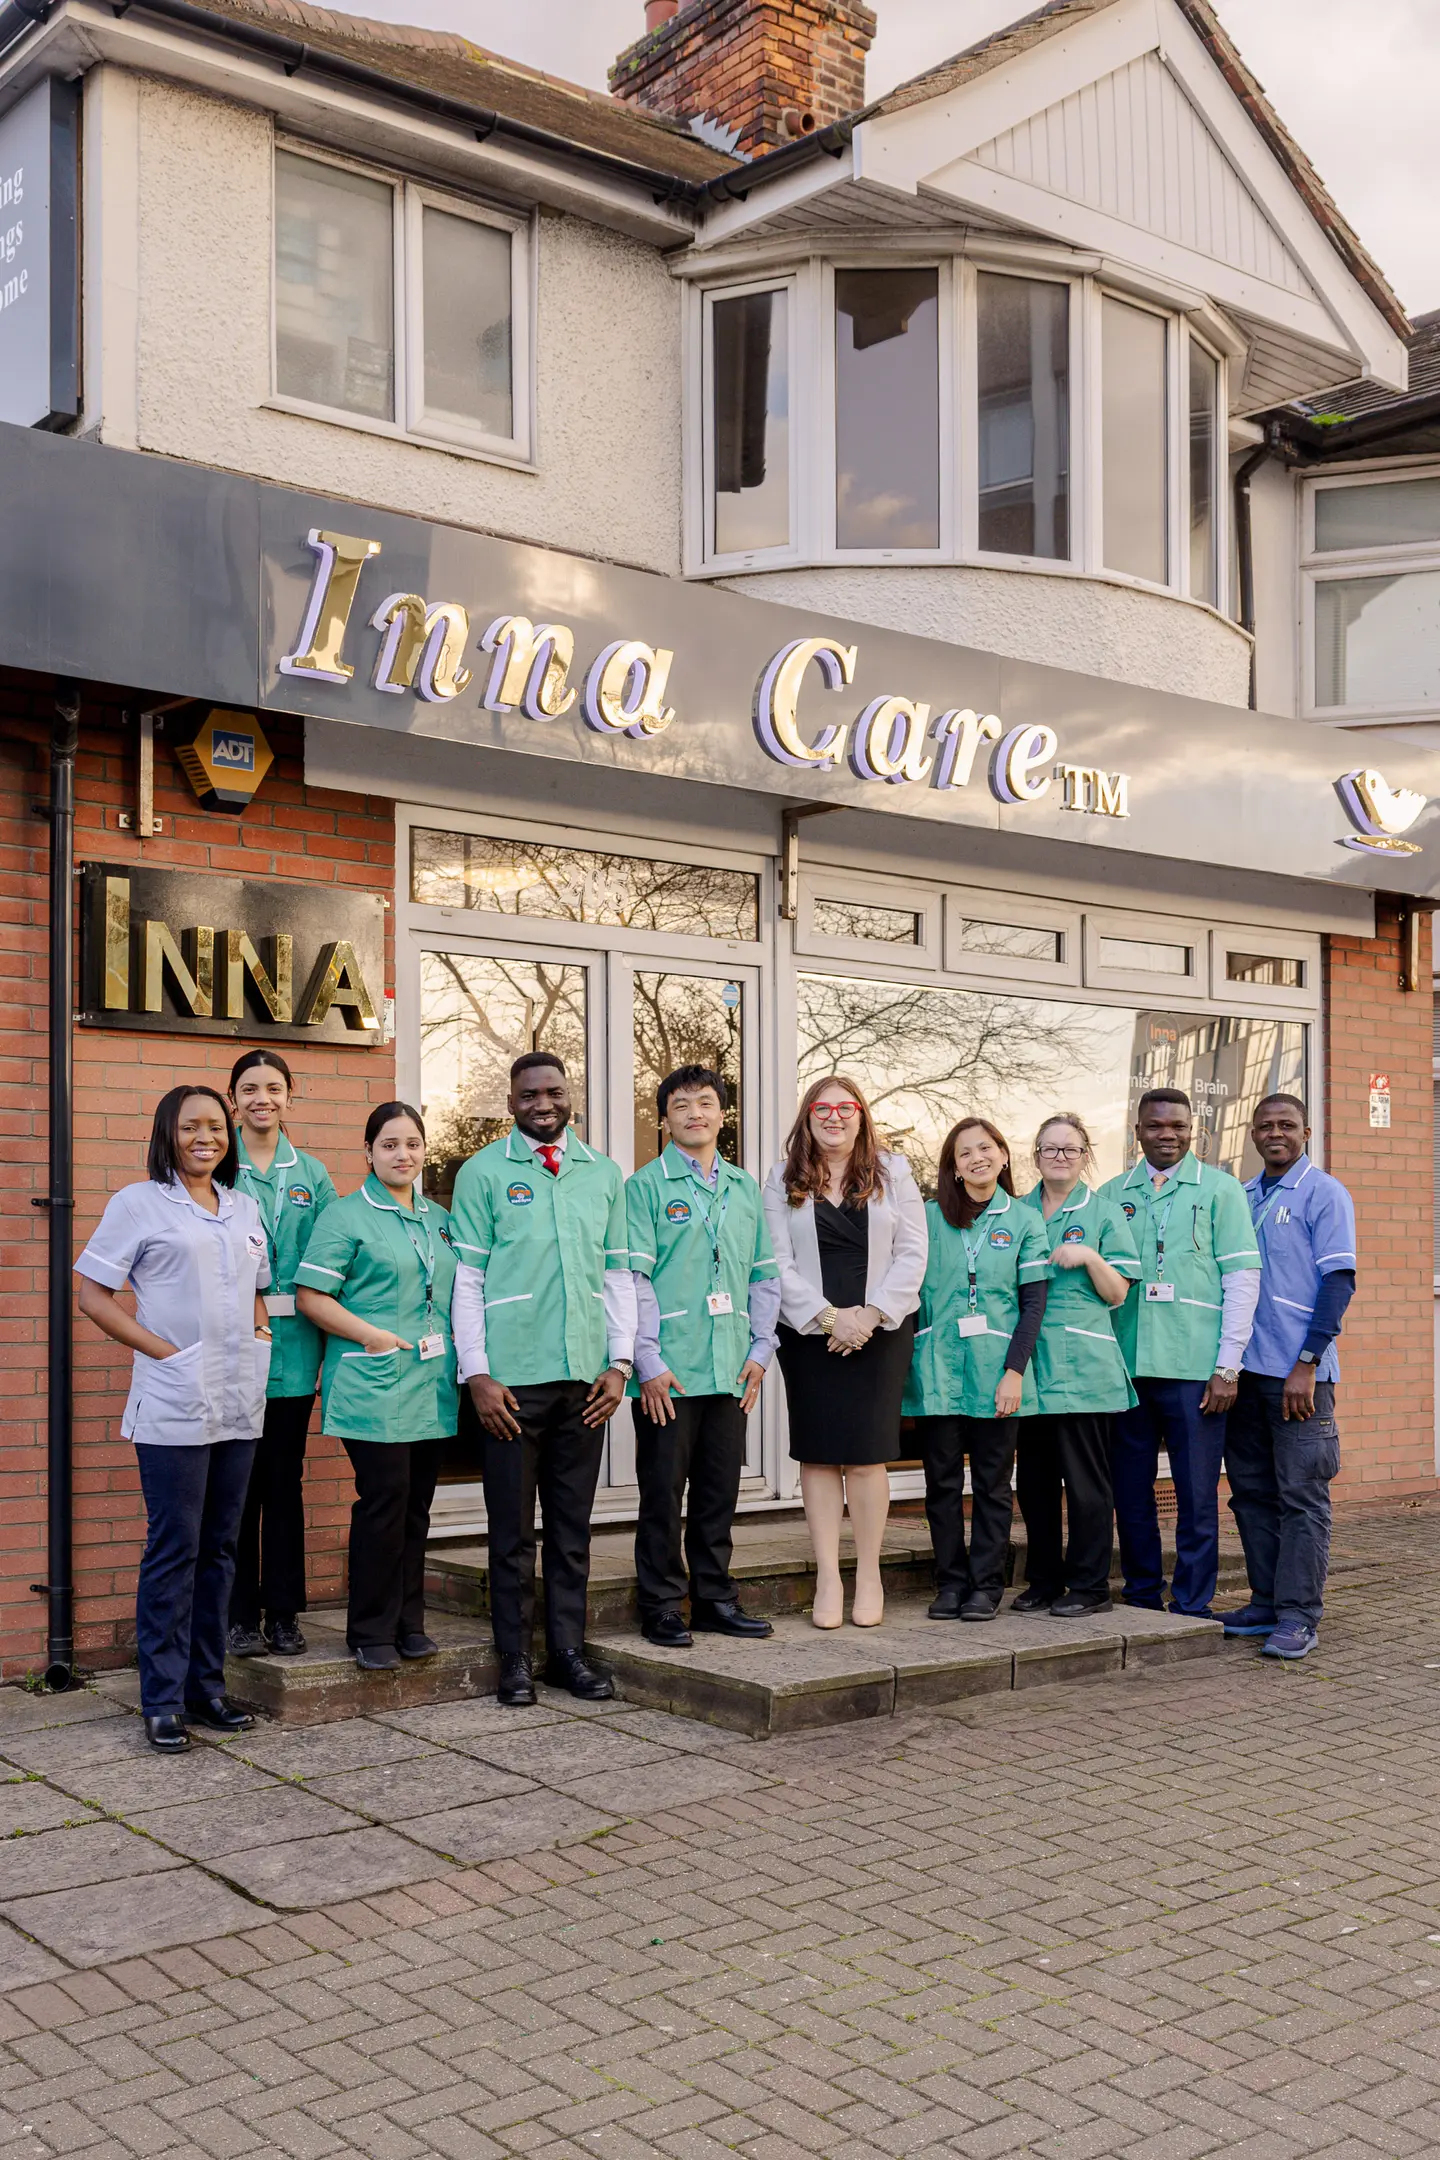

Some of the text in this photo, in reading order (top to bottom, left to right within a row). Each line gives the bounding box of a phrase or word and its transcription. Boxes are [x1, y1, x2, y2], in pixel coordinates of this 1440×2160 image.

[280, 528, 1131, 818] Inna Care TM
[213, 739, 254, 763] ADT
[559, 862, 631, 913] 205
[105, 876, 381, 1030] INNA
[1150, 1023, 1177, 1041] Inna
[1195, 1078, 1229, 1096] Brain
[1190, 1101, 1214, 1117] Life
